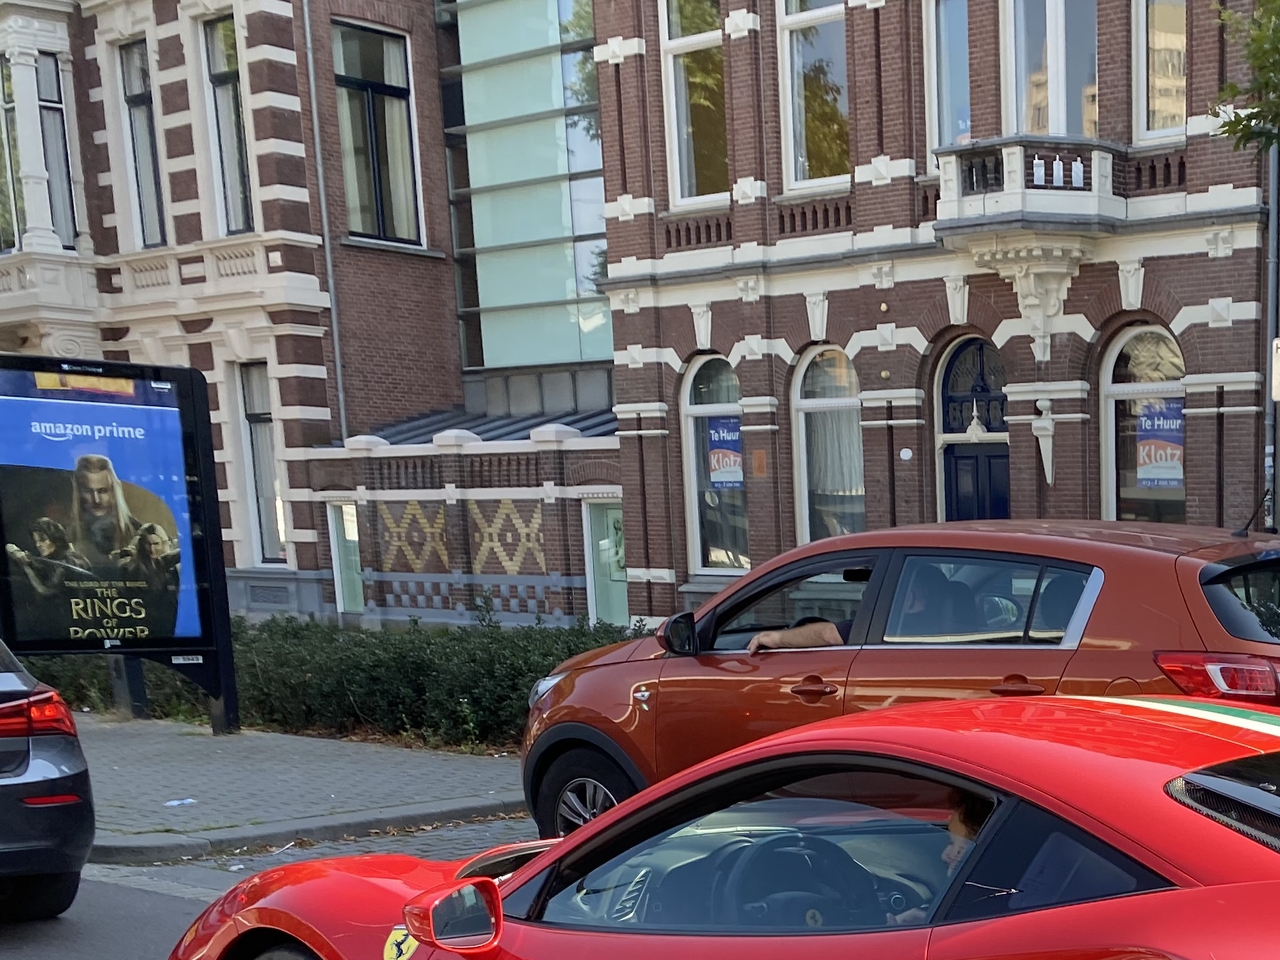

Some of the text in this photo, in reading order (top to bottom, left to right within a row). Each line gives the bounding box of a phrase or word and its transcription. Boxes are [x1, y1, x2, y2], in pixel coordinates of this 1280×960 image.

[31, 421, 145, 440] amazon prime
[1140, 416, 1182, 430] Te Huur
[709, 428, 740, 442] Te Huur
[710, 452, 741, 470] Klotz
[1139, 444, 1182, 464] Klotz
[95, 588, 119, 598] THE
[70, 598, 147, 620] RINGS
[102, 618, 119, 627] OF
[69, 625, 150, 640] POWER
